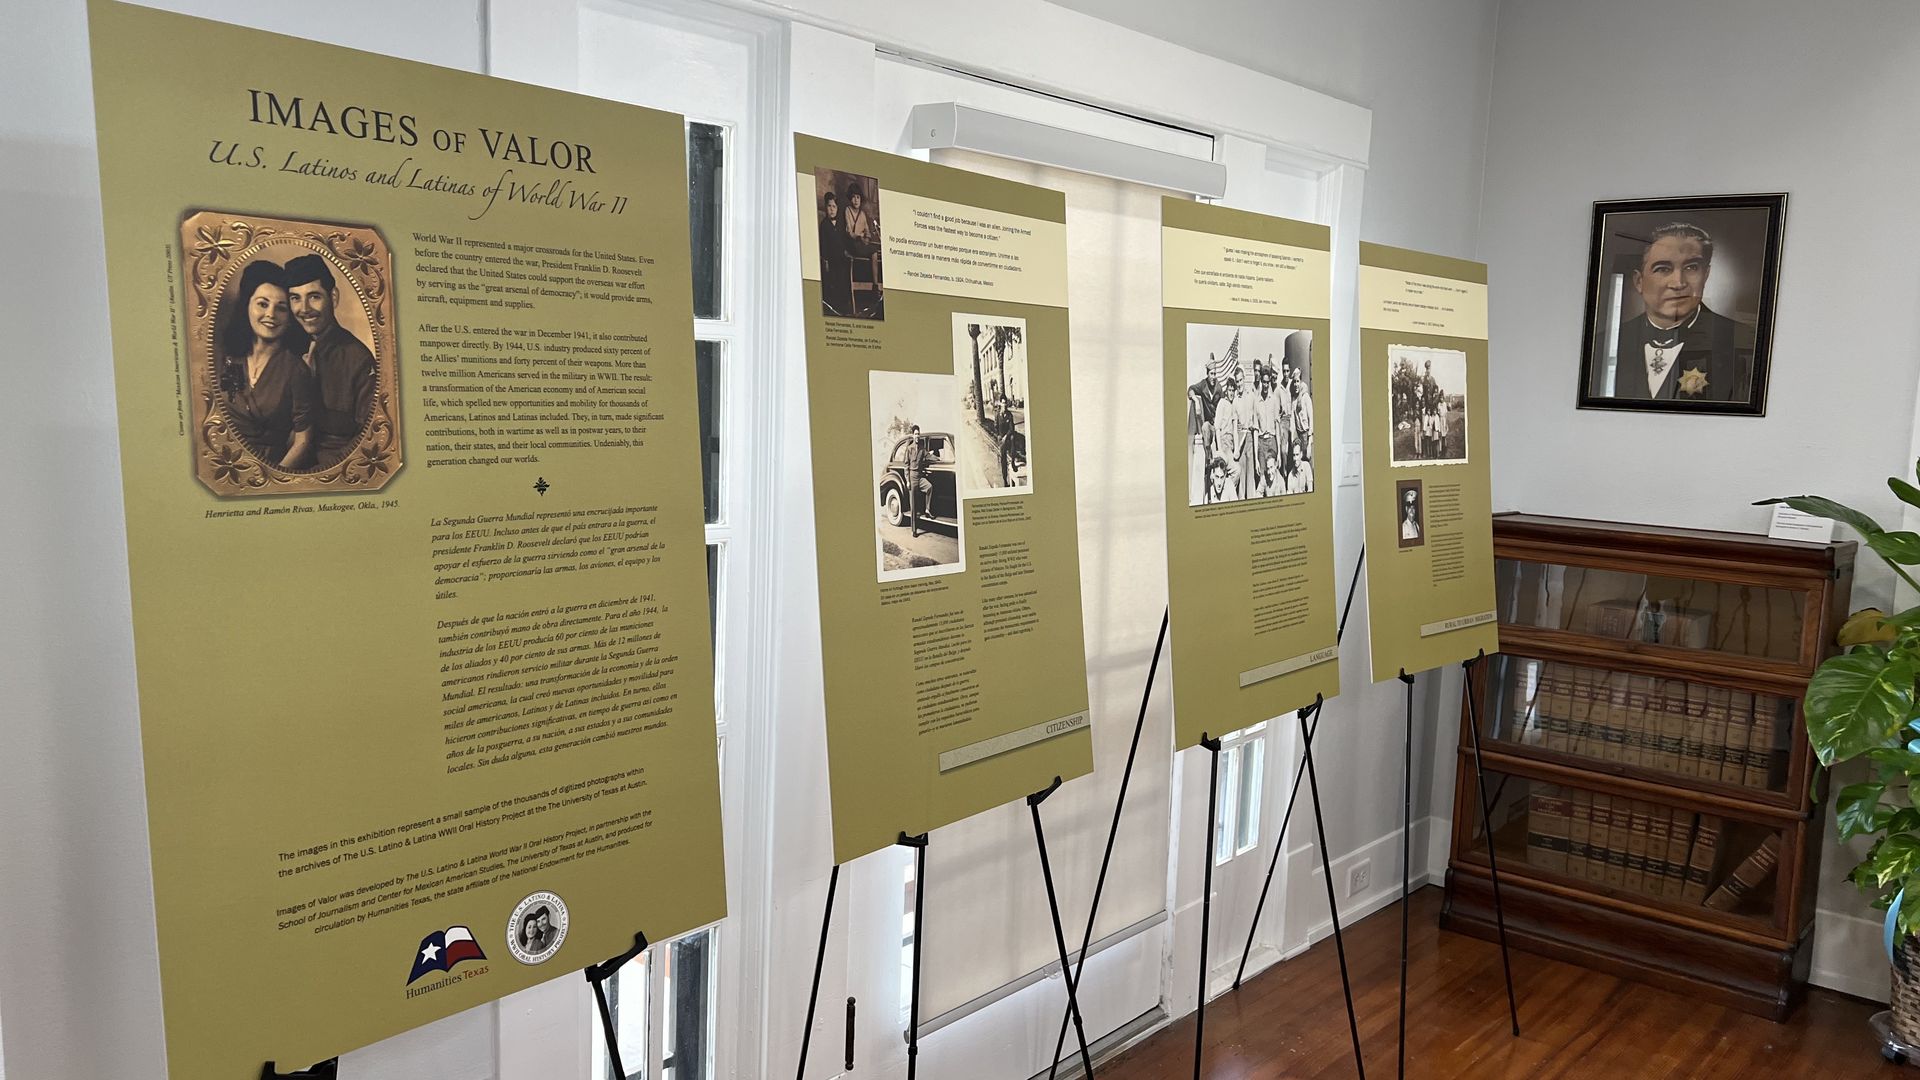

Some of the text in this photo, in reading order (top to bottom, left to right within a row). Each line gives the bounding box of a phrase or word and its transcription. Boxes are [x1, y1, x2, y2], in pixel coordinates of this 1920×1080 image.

[248, 88, 597, 174] IMAGES OF VALOR
[208, 140, 628, 221] U.S. Latinos and Latinas of World War II
[413, 232, 437, 245] World
[439, 235, 454, 245] War
[456, 237, 462, 246] II
[464, 239, 506, 252] represented
[513, 243, 534, 254] major
[535, 247, 571, 256] crossroads
[572, 248, 582, 257] for
[583, 249, 594, 259] the
[594, 251, 616, 262] United
[617, 253, 638, 263] States.
[639, 255, 655, 264] Even
[414, 247, 643, 277] before the country entered the war, President Franklin D. Roosevelt
[415, 262, 645, 290] declared that the United States could support the overseas war effort
[416, 277, 427, 289] by
[428, 279, 457, 292] serving
[481, 283, 504, 295] “great
[504, 285, 530, 295] arsenal
[531, 286, 539, 296] of
[590, 289, 610, 301] would
[611, 294, 635, 303] provide
[417, 293, 534, 310] aircraft, equipment and supplies.
[427, 457, 467, 468] generation
[468, 455, 499, 466] changed
[514, 454, 539, 463] worlds.
[205, 510, 245, 519] Henrietta
[246, 507, 262, 516] and
[263, 506, 291, 515] Ramón
[430, 505, 658, 528] La Segunda Guerra Mundial representó una encrucijada importante
[1046, 716, 1083, 734] CITIZENSHIP
[279, 852, 295, 862] The
[297, 844, 329, 857] images
[330, 841, 338, 849] in
[340, 837, 356, 847] this
[357, 828, 396, 843] exhibition
[397, 817, 435, 833] represent
[442, 810, 463, 822] small
[464, 804, 491, 817] sample
[492, 801, 500, 810] of
[500, 799, 513, 808] the
[513, 790, 550, 805] thousands
[550, 787, 558, 796] of
[558, 780, 586, 795] digitized
[587, 772, 626, 791] photographs
[626, 767, 644, 777] within
[524, 894, 546, 905] LATINO
[551, 897, 565, 915] LATINA
[406, 965, 489, 1000] Humanities Texas
